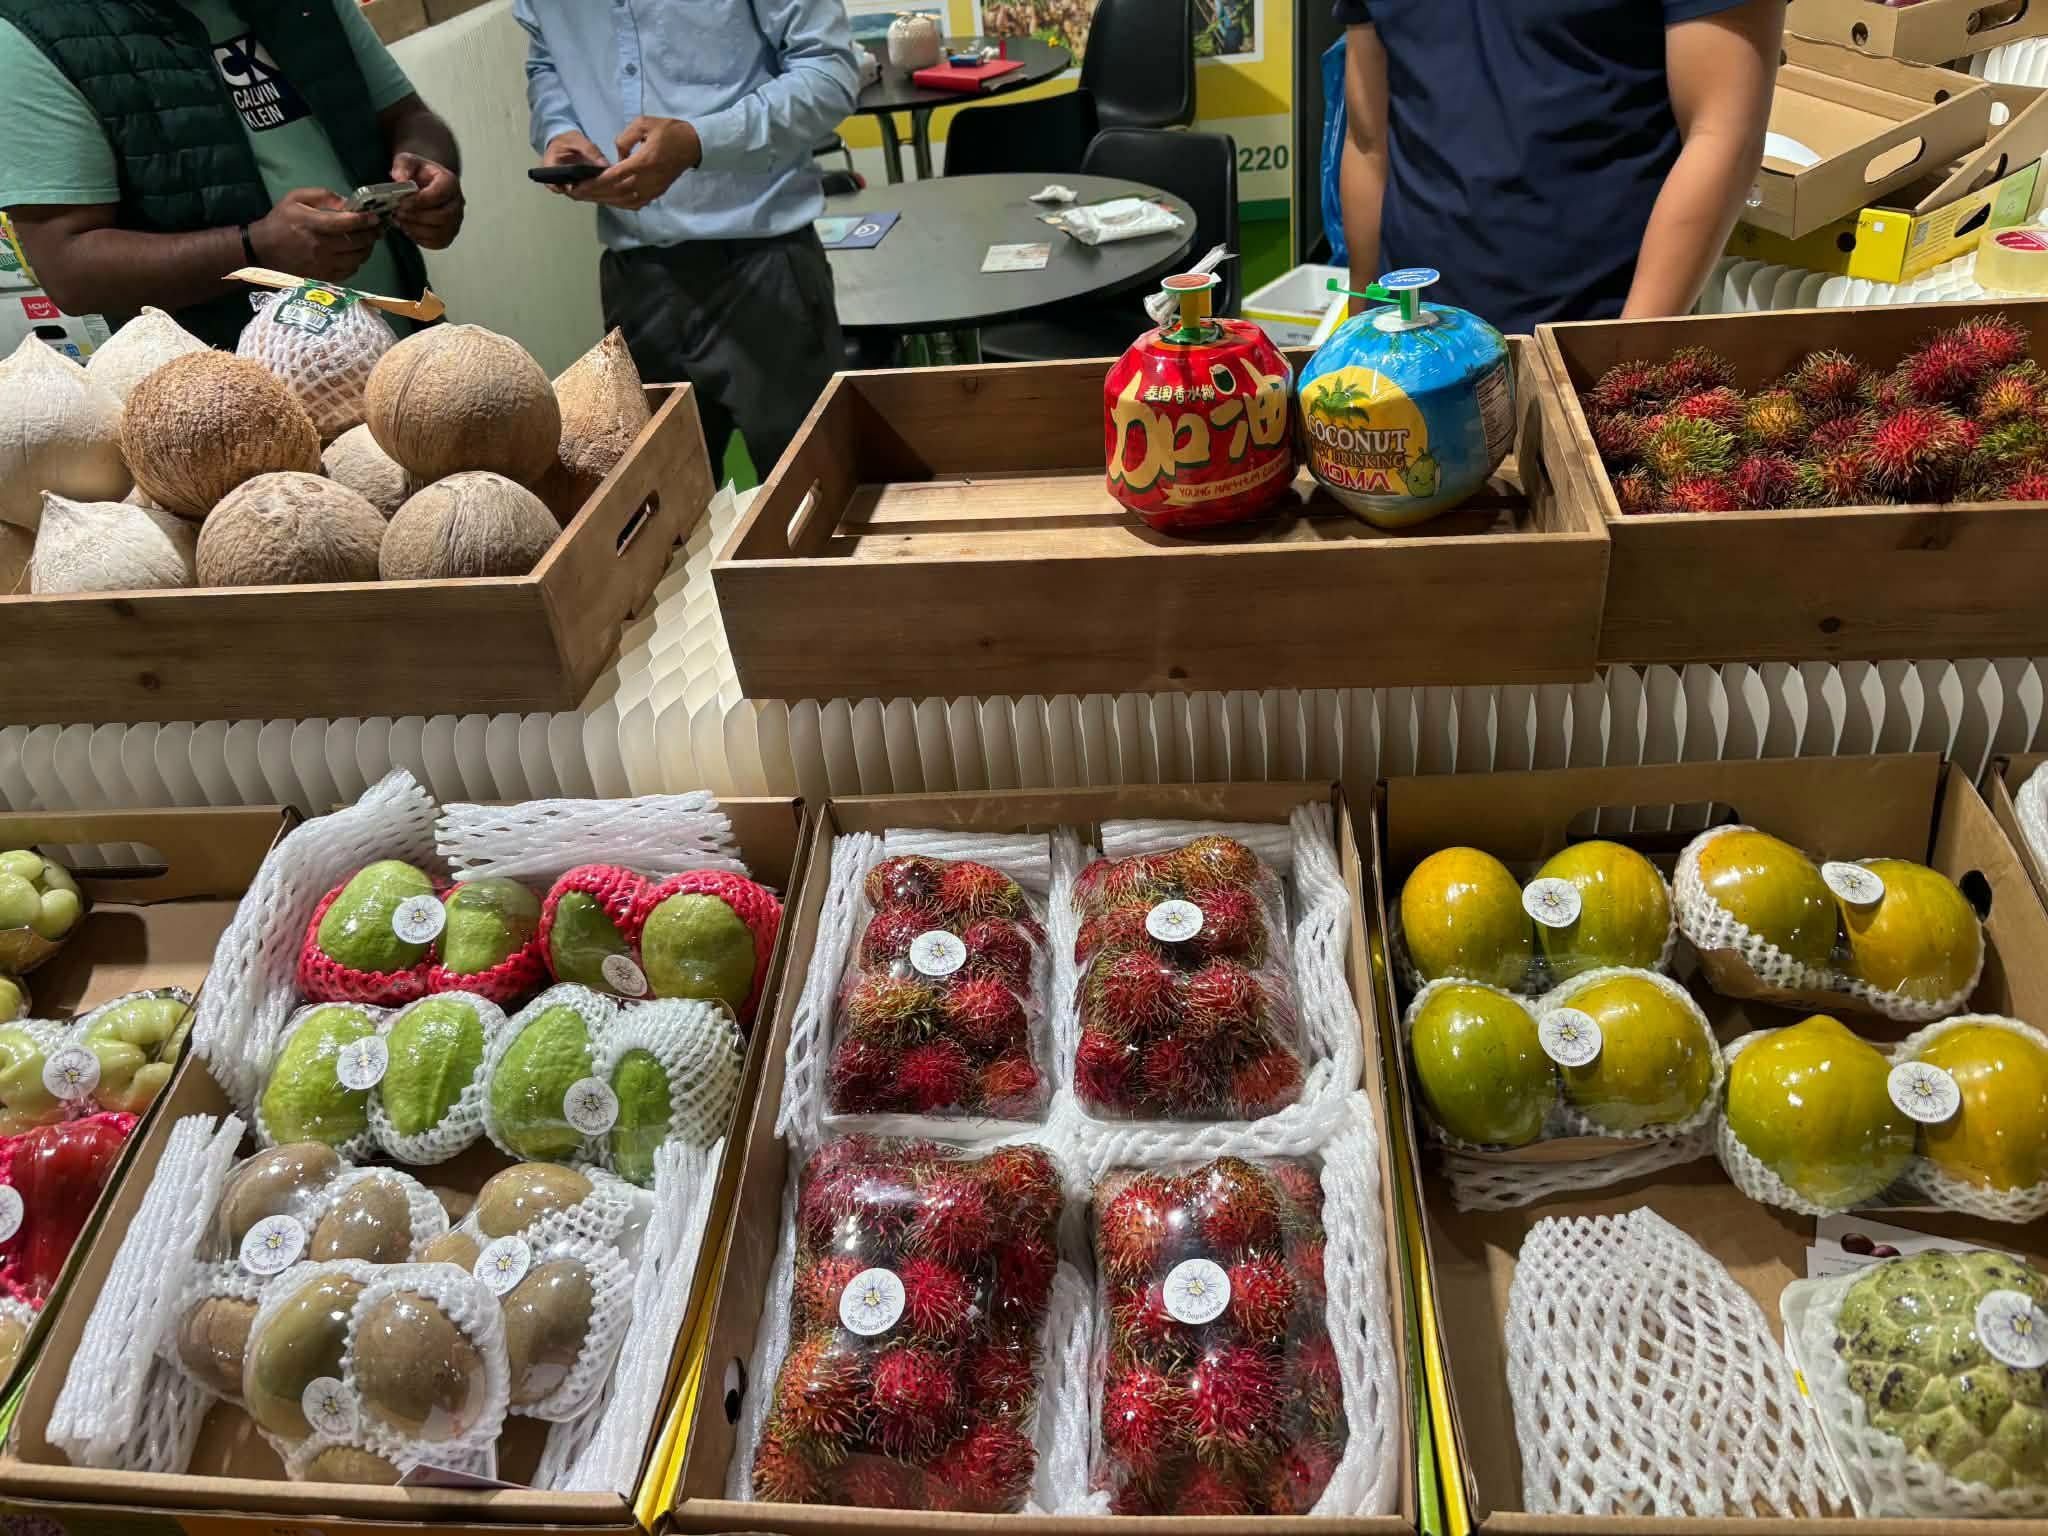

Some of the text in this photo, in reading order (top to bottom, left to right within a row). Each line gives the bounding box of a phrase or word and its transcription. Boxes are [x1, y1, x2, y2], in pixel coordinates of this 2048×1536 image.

[233, 82, 281, 109] CALVIN
[242, 104, 285, 129] KLEIN
[1239, 145, 1289, 172] 220
[1307, 414, 1410, 451] COCONUT
[1333, 449, 1406, 472] DRINKING
[1179, 484, 1211, 497] YOUNG
